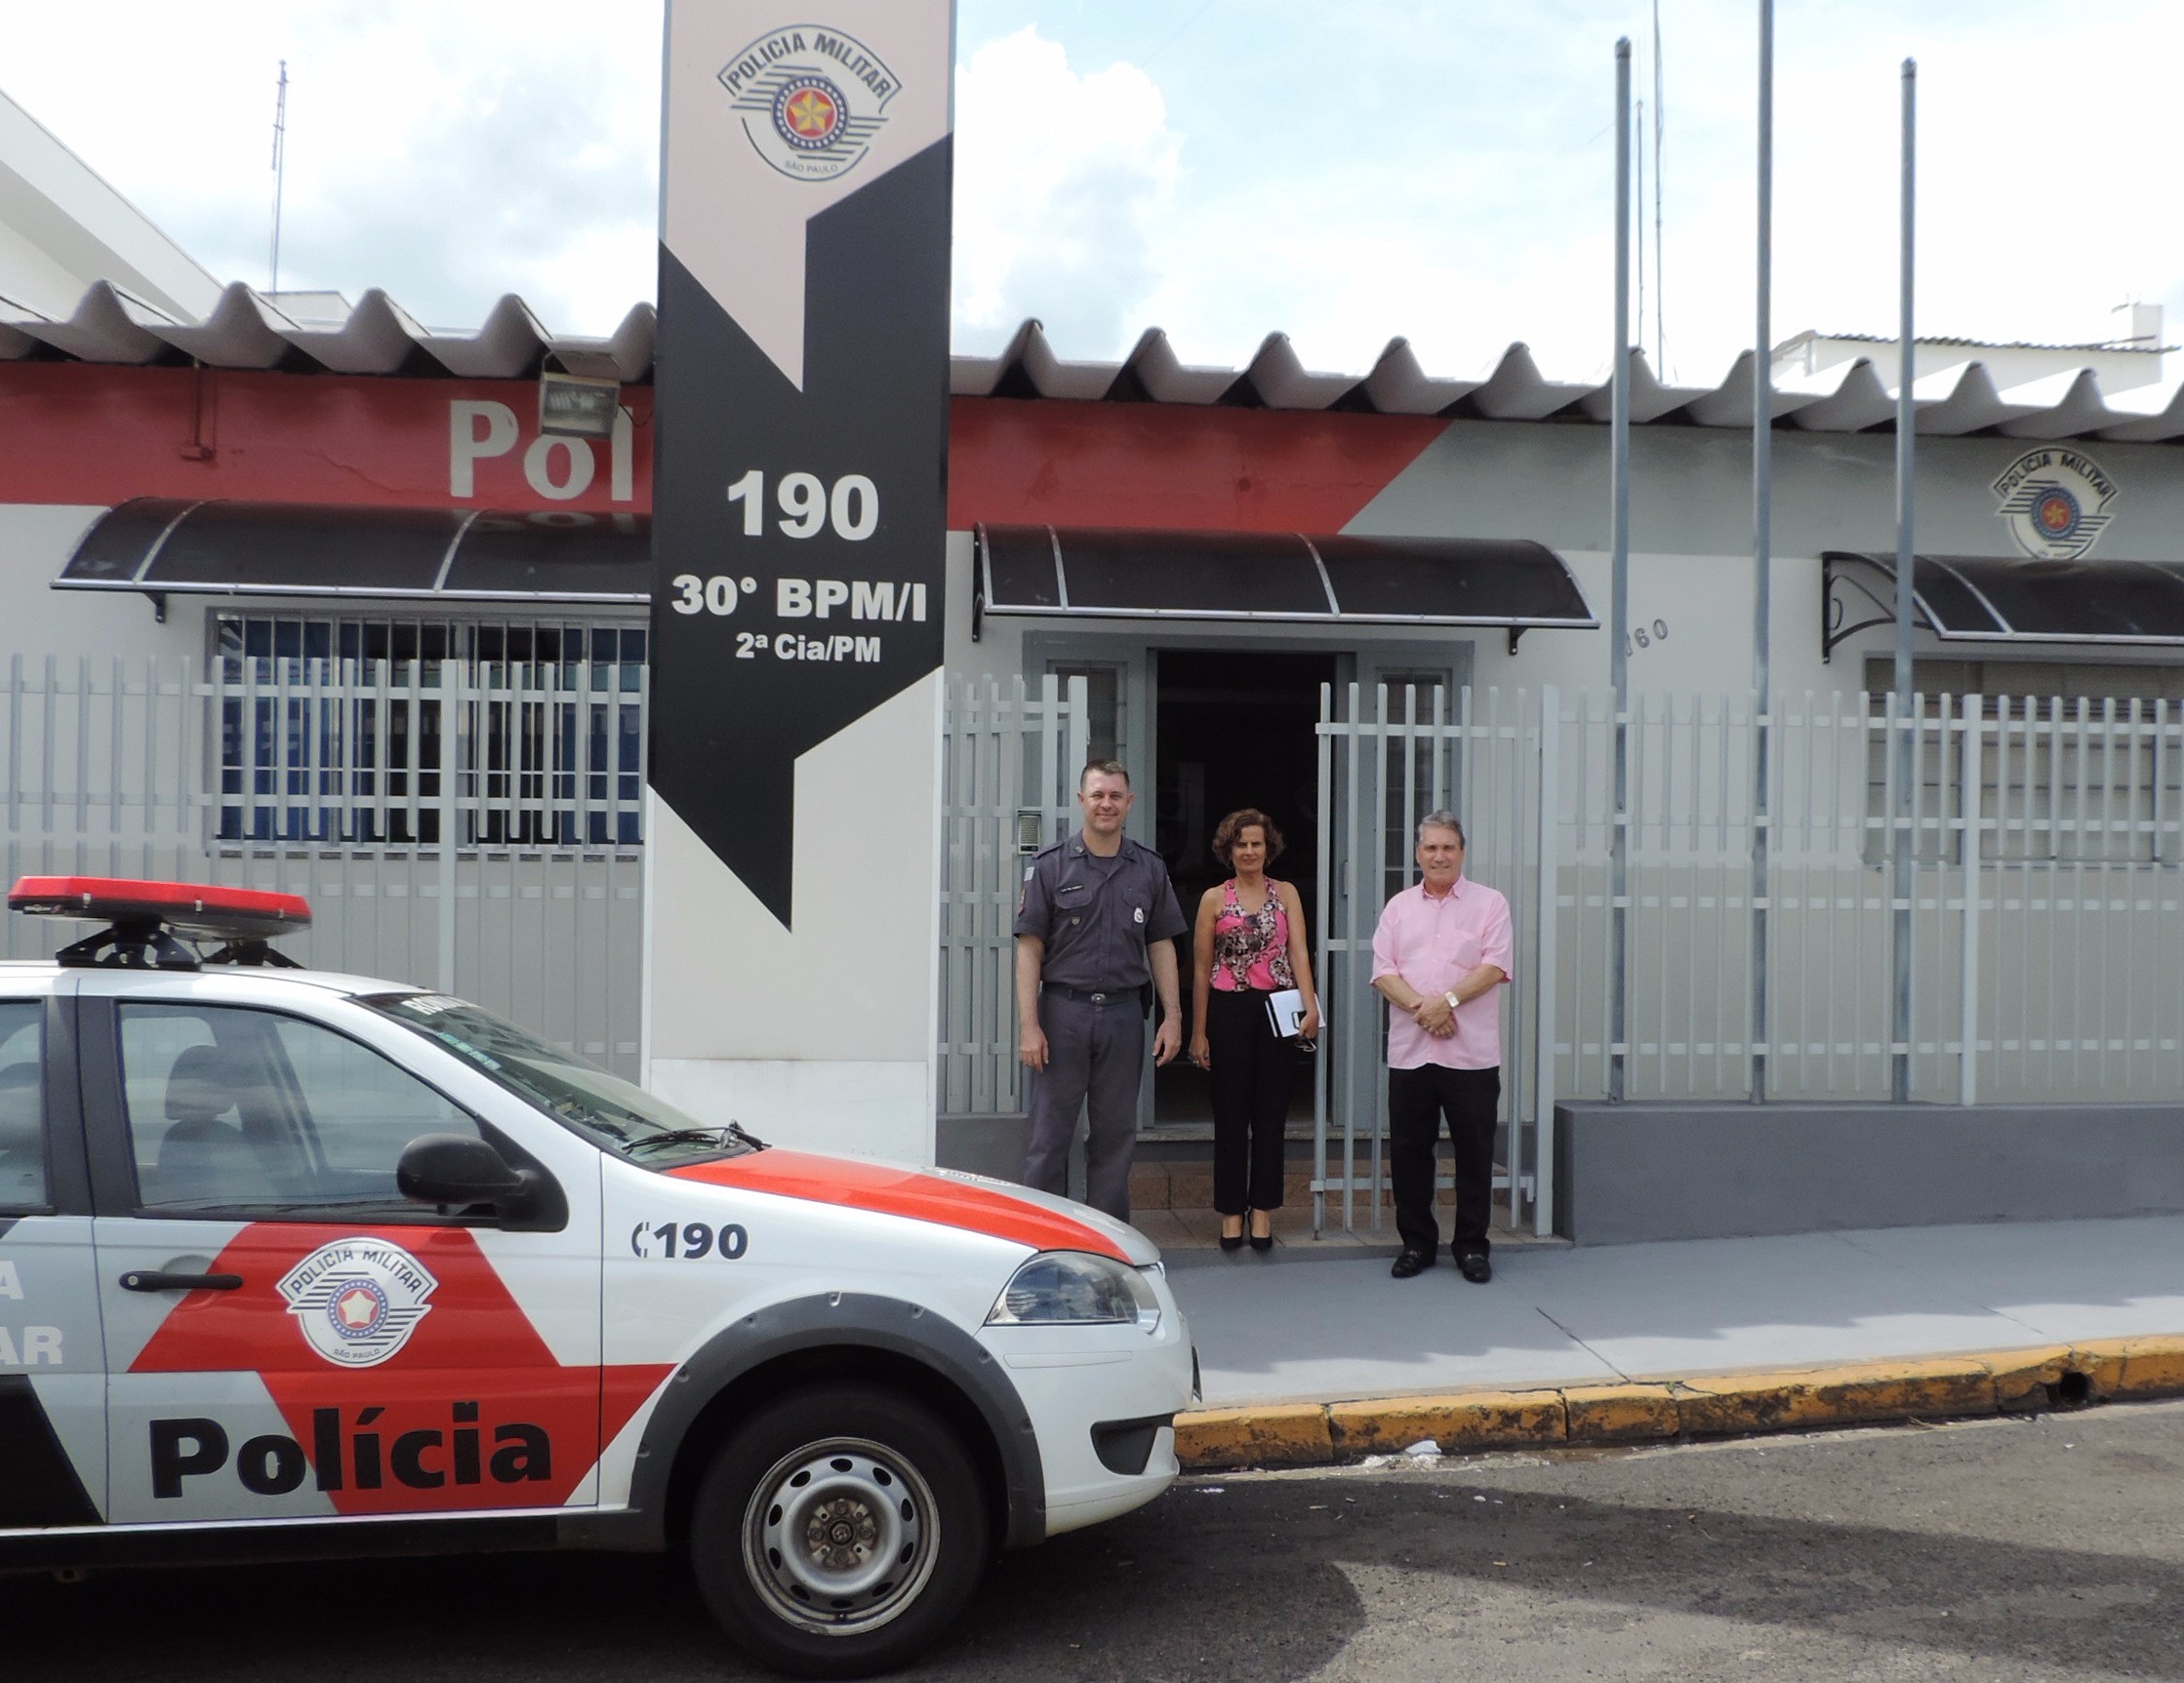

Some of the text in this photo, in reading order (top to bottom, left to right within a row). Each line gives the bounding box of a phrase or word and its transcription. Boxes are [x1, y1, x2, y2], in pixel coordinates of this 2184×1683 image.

[813, 32, 891, 100] MILITAR
[784, 160, 839, 174] SÃO PAULO
[2060, 453, 2112, 497] MILITAR
[727, 469, 879, 541] 190
[777, 578, 927, 621] BPM/I
[774, 634, 881, 662] Cia/PM
[653, 1222, 748, 1260] 190
[361, 1250, 423, 1294] MILITAR
[334, 1347, 381, 1360] SÃO PAULO
[148, 1401, 552, 1500] Polícia
